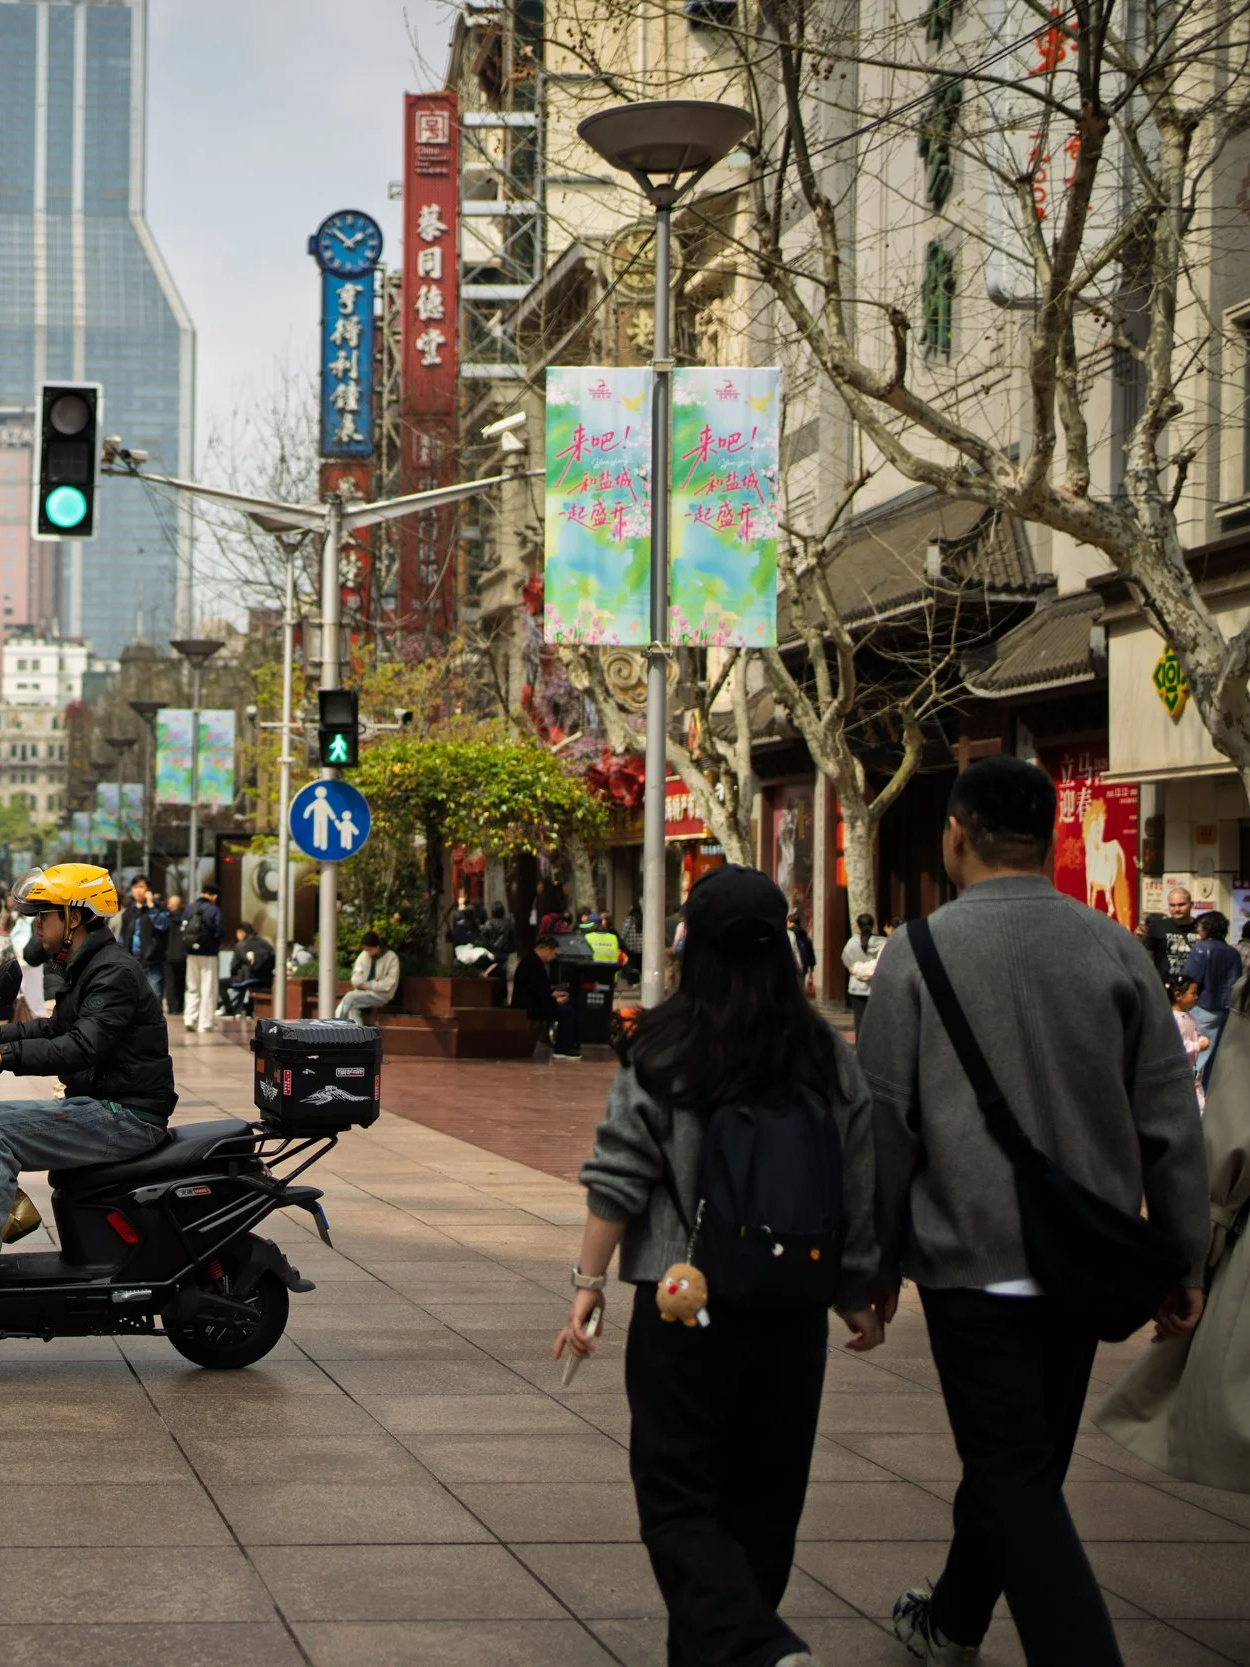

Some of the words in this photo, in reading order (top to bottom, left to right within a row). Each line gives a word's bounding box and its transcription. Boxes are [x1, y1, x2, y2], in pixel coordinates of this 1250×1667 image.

[567, 466, 637, 502] 和盐城
[694, 467, 764, 504] 和盐城
[558, 499, 633, 544] 一起盛开
[684, 500, 759, 545] 一起盛开
[1059, 787, 1092, 823] 迎春
